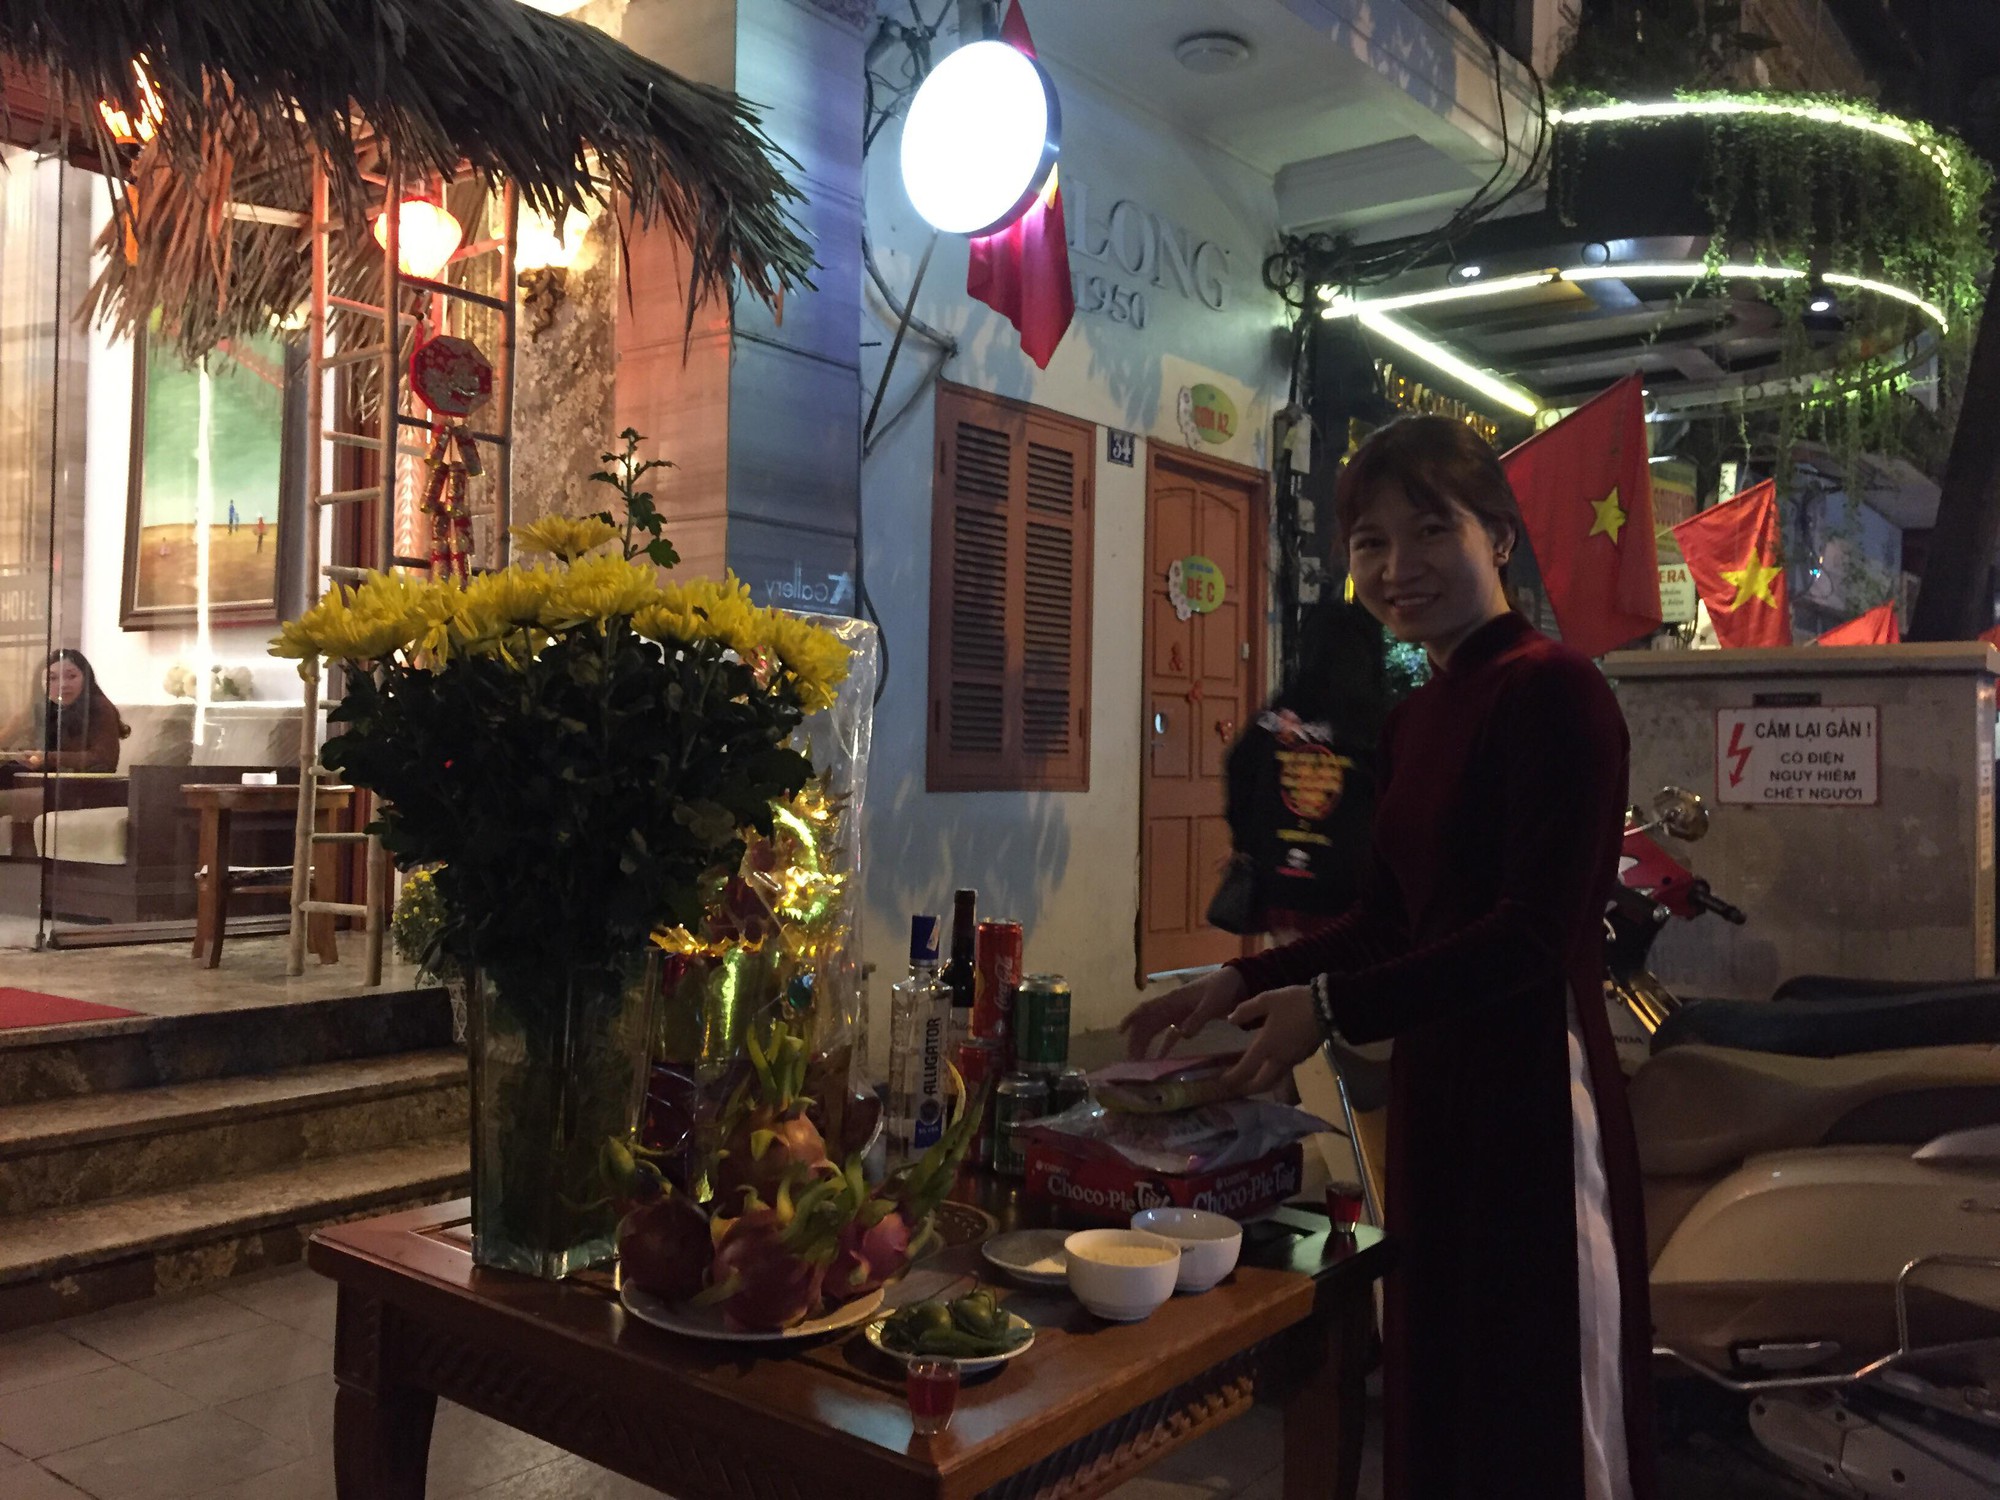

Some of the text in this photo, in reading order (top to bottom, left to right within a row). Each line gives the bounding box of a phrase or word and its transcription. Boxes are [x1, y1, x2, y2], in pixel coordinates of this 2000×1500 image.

[1067, 177, 1231, 312] LONG
[1072, 271, 1148, 329] 1950
[1112, 433, 1132, 462] 34
[1796, 722, 1820, 742] LẠI
[1770, 770, 1812, 782] NGUY
[923, 1017, 941, 1096] ALLIGATOR
